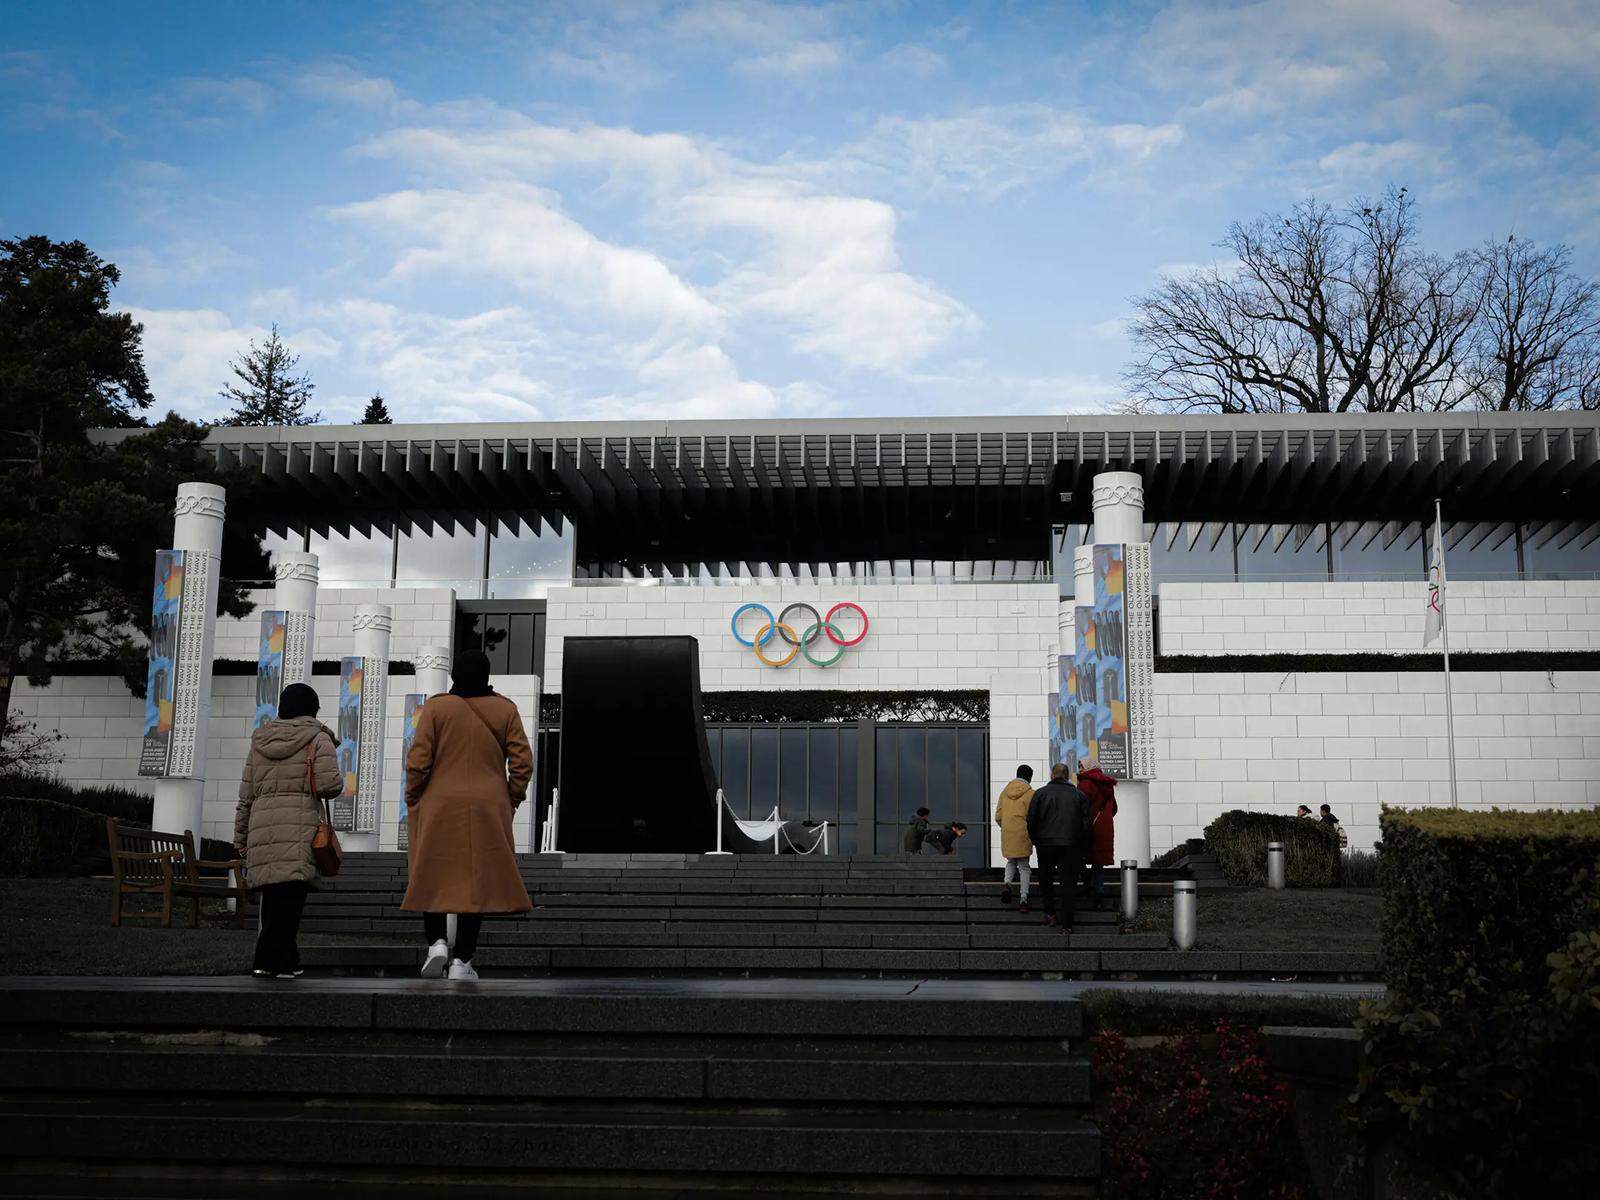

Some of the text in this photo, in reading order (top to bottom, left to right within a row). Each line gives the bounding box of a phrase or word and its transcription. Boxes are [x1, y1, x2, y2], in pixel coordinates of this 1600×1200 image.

[186, 552, 194, 575] WAVE
[193, 552, 201, 575] WAVE
[183, 578, 192, 612] OLYMPIC
[190, 578, 199, 612] OLYMPIC
[197, 578, 206, 612] OLYMPIC
[179, 633, 187, 660] RIDING
[194, 633, 202, 660] RIDING
[292, 634, 300, 665] OLYMPIC
[177, 663, 185, 686] WAVE
[174, 688, 183, 724] OLYMPIC
[182, 688, 190, 724] OLYMPIC
[189, 688, 197, 724] OLYMPIC
[178, 745, 186, 773] RIDING
